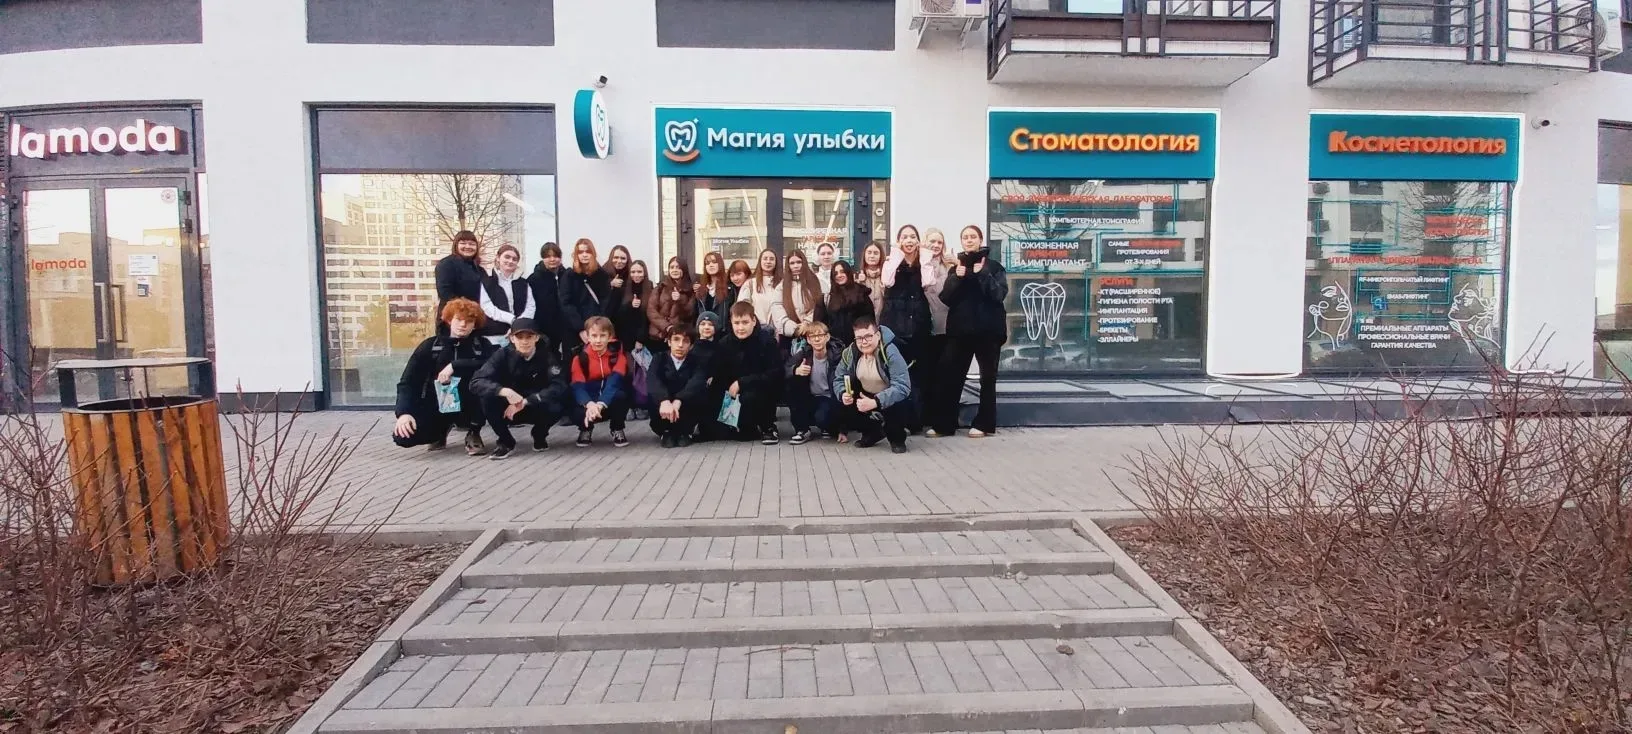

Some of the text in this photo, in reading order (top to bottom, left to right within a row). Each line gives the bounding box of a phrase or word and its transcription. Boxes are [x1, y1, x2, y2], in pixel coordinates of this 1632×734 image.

[11, 119, 176, 158] lamoda
[707, 127, 885, 154] Магия улыбки
[1009, 127, 1200, 152] Стоматология
[1328, 131, 1507, 155] Косметология
[1015, 241, 1079, 250] ПОЖИЗНЕННАЯ
[31, 258, 87, 271] lamoda
